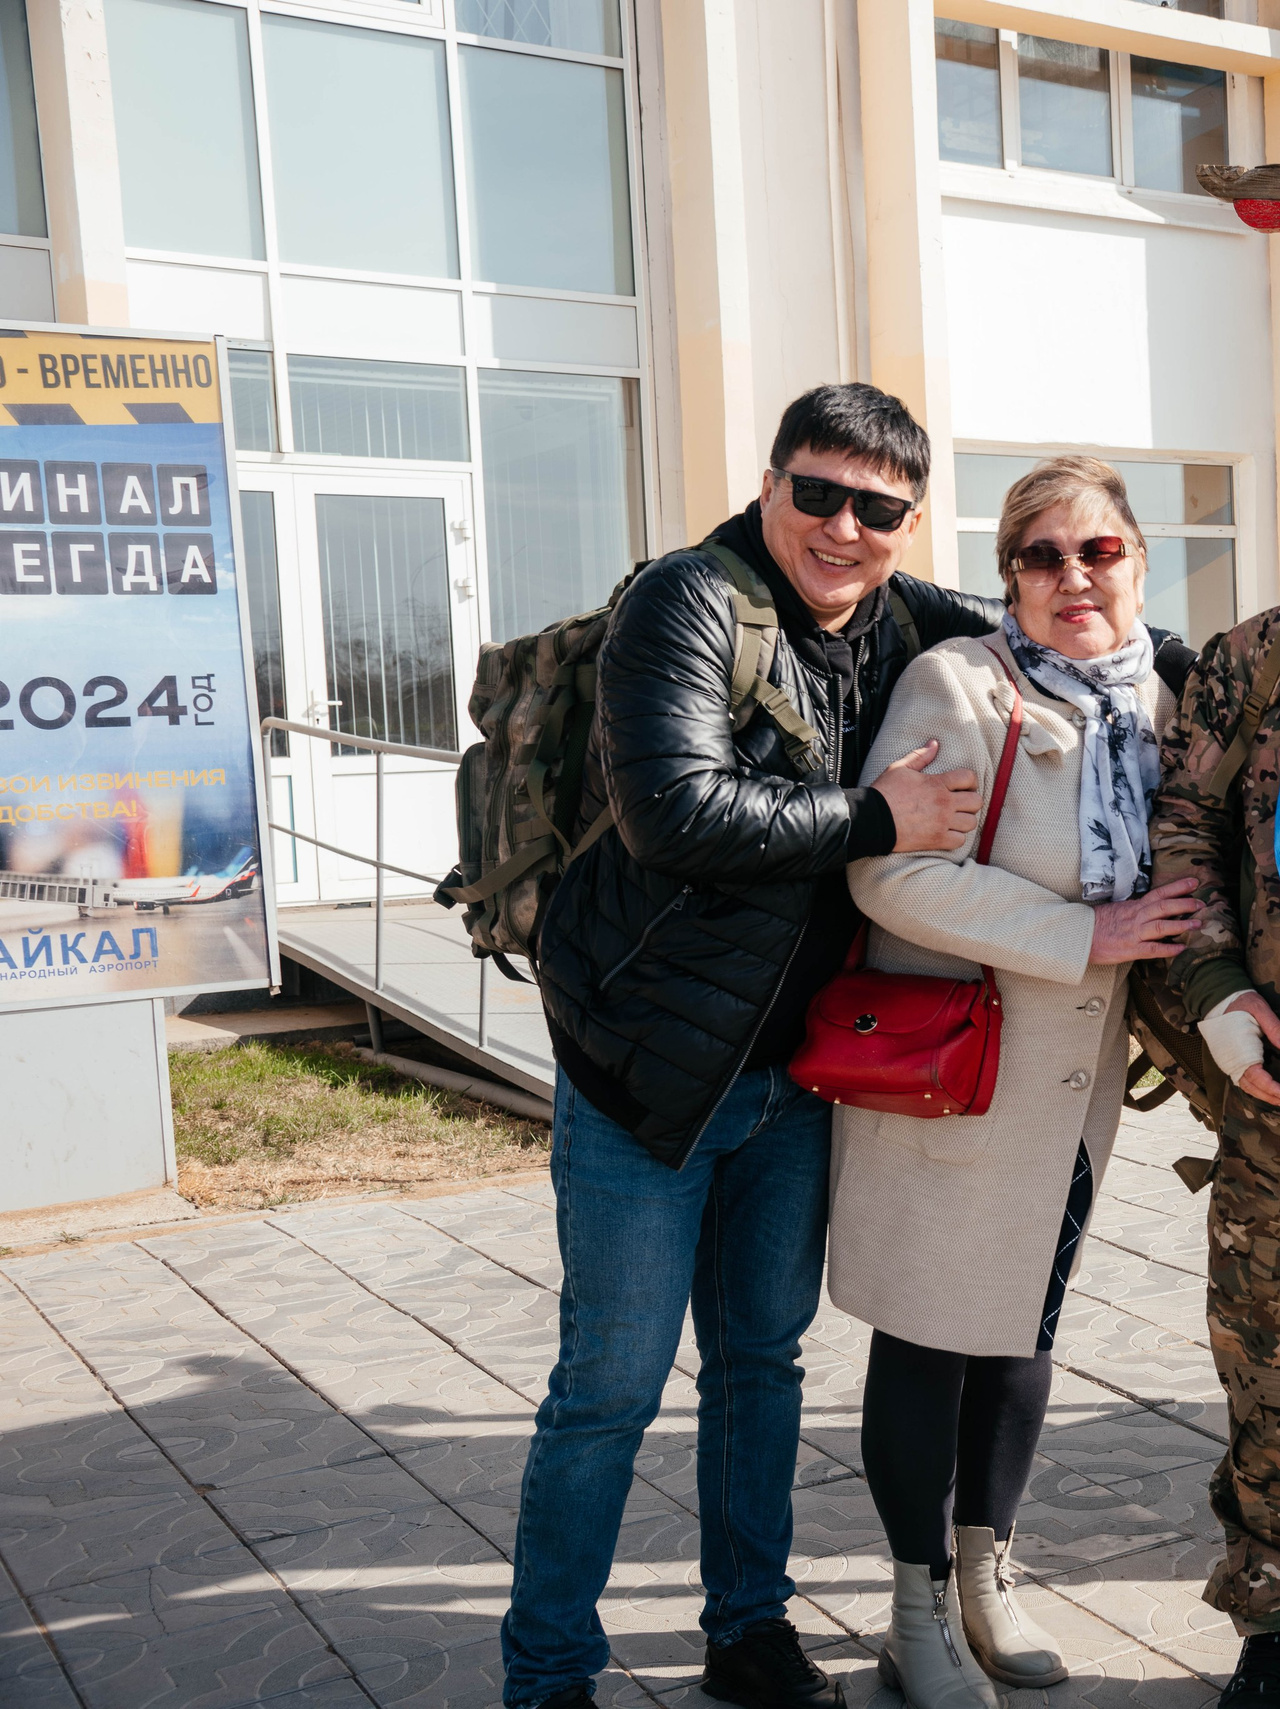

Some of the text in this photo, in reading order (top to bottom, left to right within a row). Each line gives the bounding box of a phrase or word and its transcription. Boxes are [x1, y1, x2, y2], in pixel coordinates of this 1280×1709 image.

[38, 353, 212, 389] ВРЕМЕННО
[0, 471, 200, 515] ИНАЛ
[12, 543, 212, 592] ЕГДА
[191, 673, 216, 726] ГОД
[58, 768, 226, 792] ИЗВИНЕНИЯ
[89, 959, 159, 974] АЭРОПОРТ
